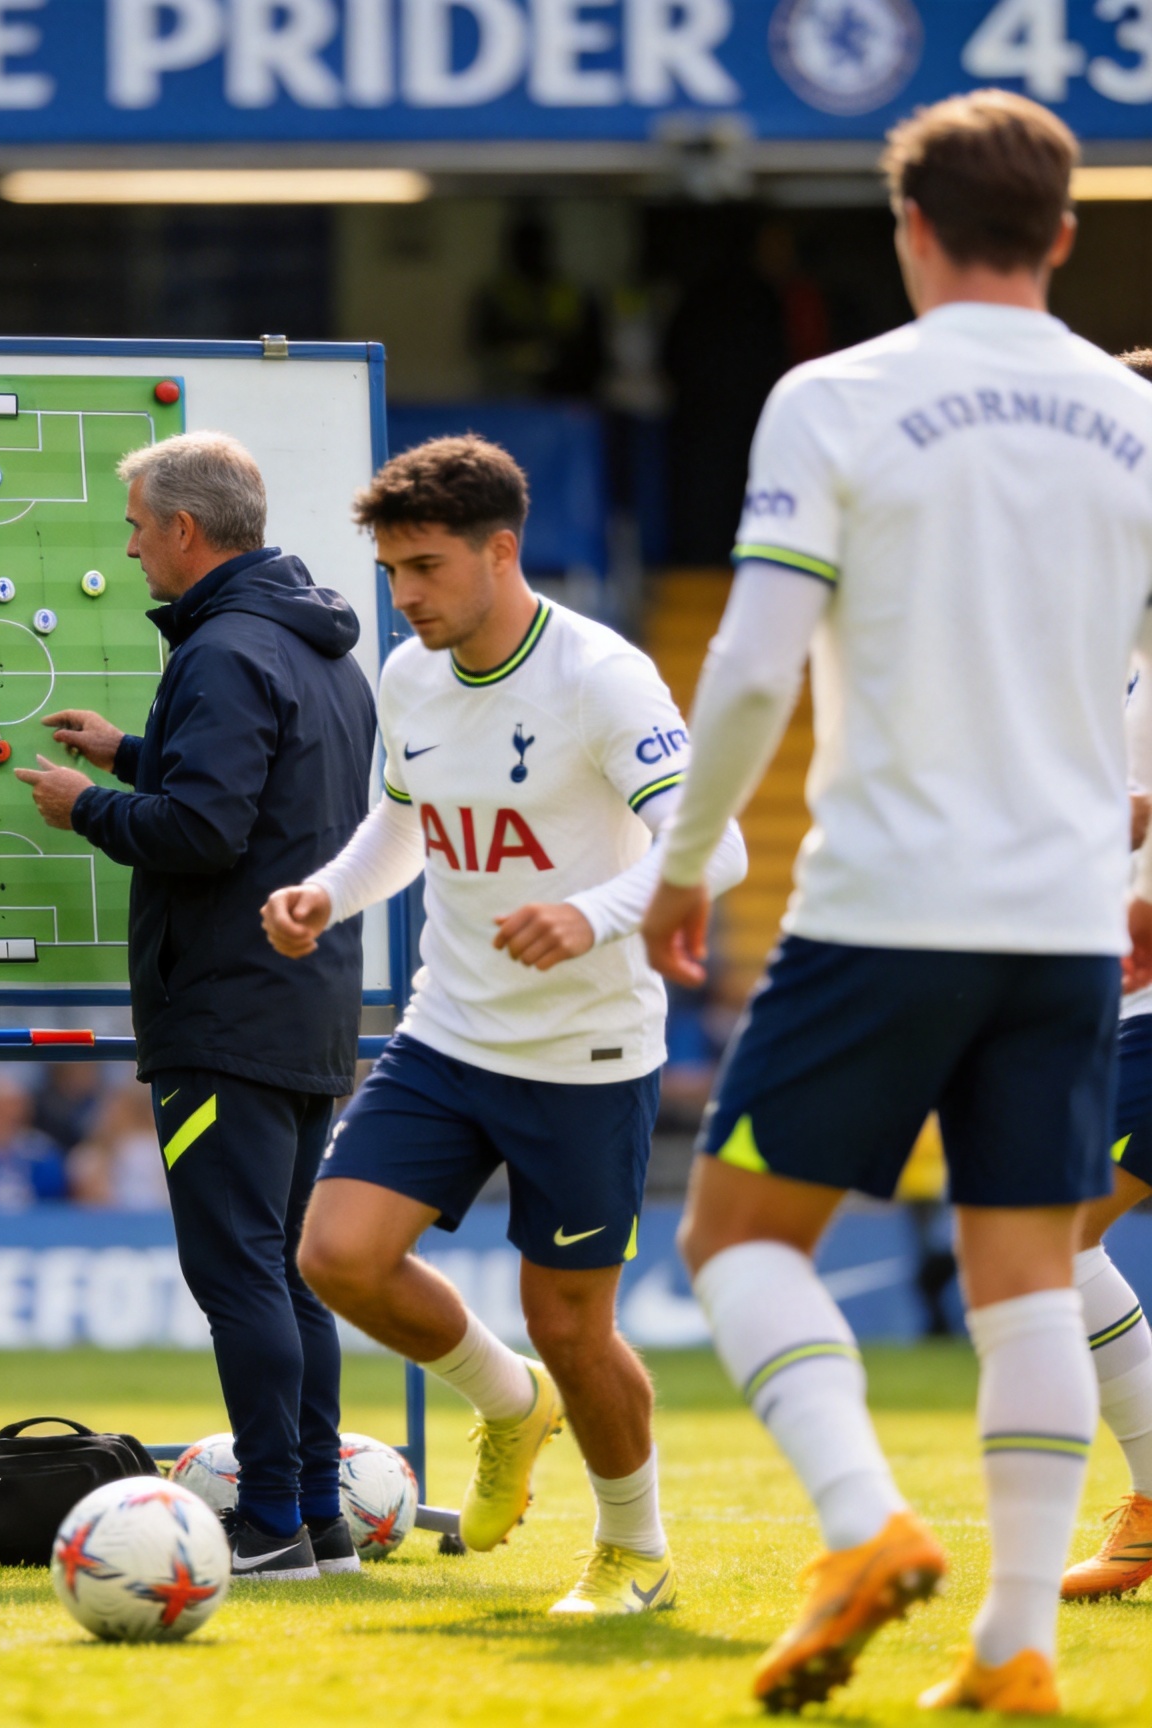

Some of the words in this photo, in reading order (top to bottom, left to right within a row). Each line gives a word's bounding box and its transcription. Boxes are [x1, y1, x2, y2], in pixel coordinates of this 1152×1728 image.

[106, 0, 743, 108] PRIDER
[961, 0, 1152, 103] 43
[420, 803, 555, 872] AIA
